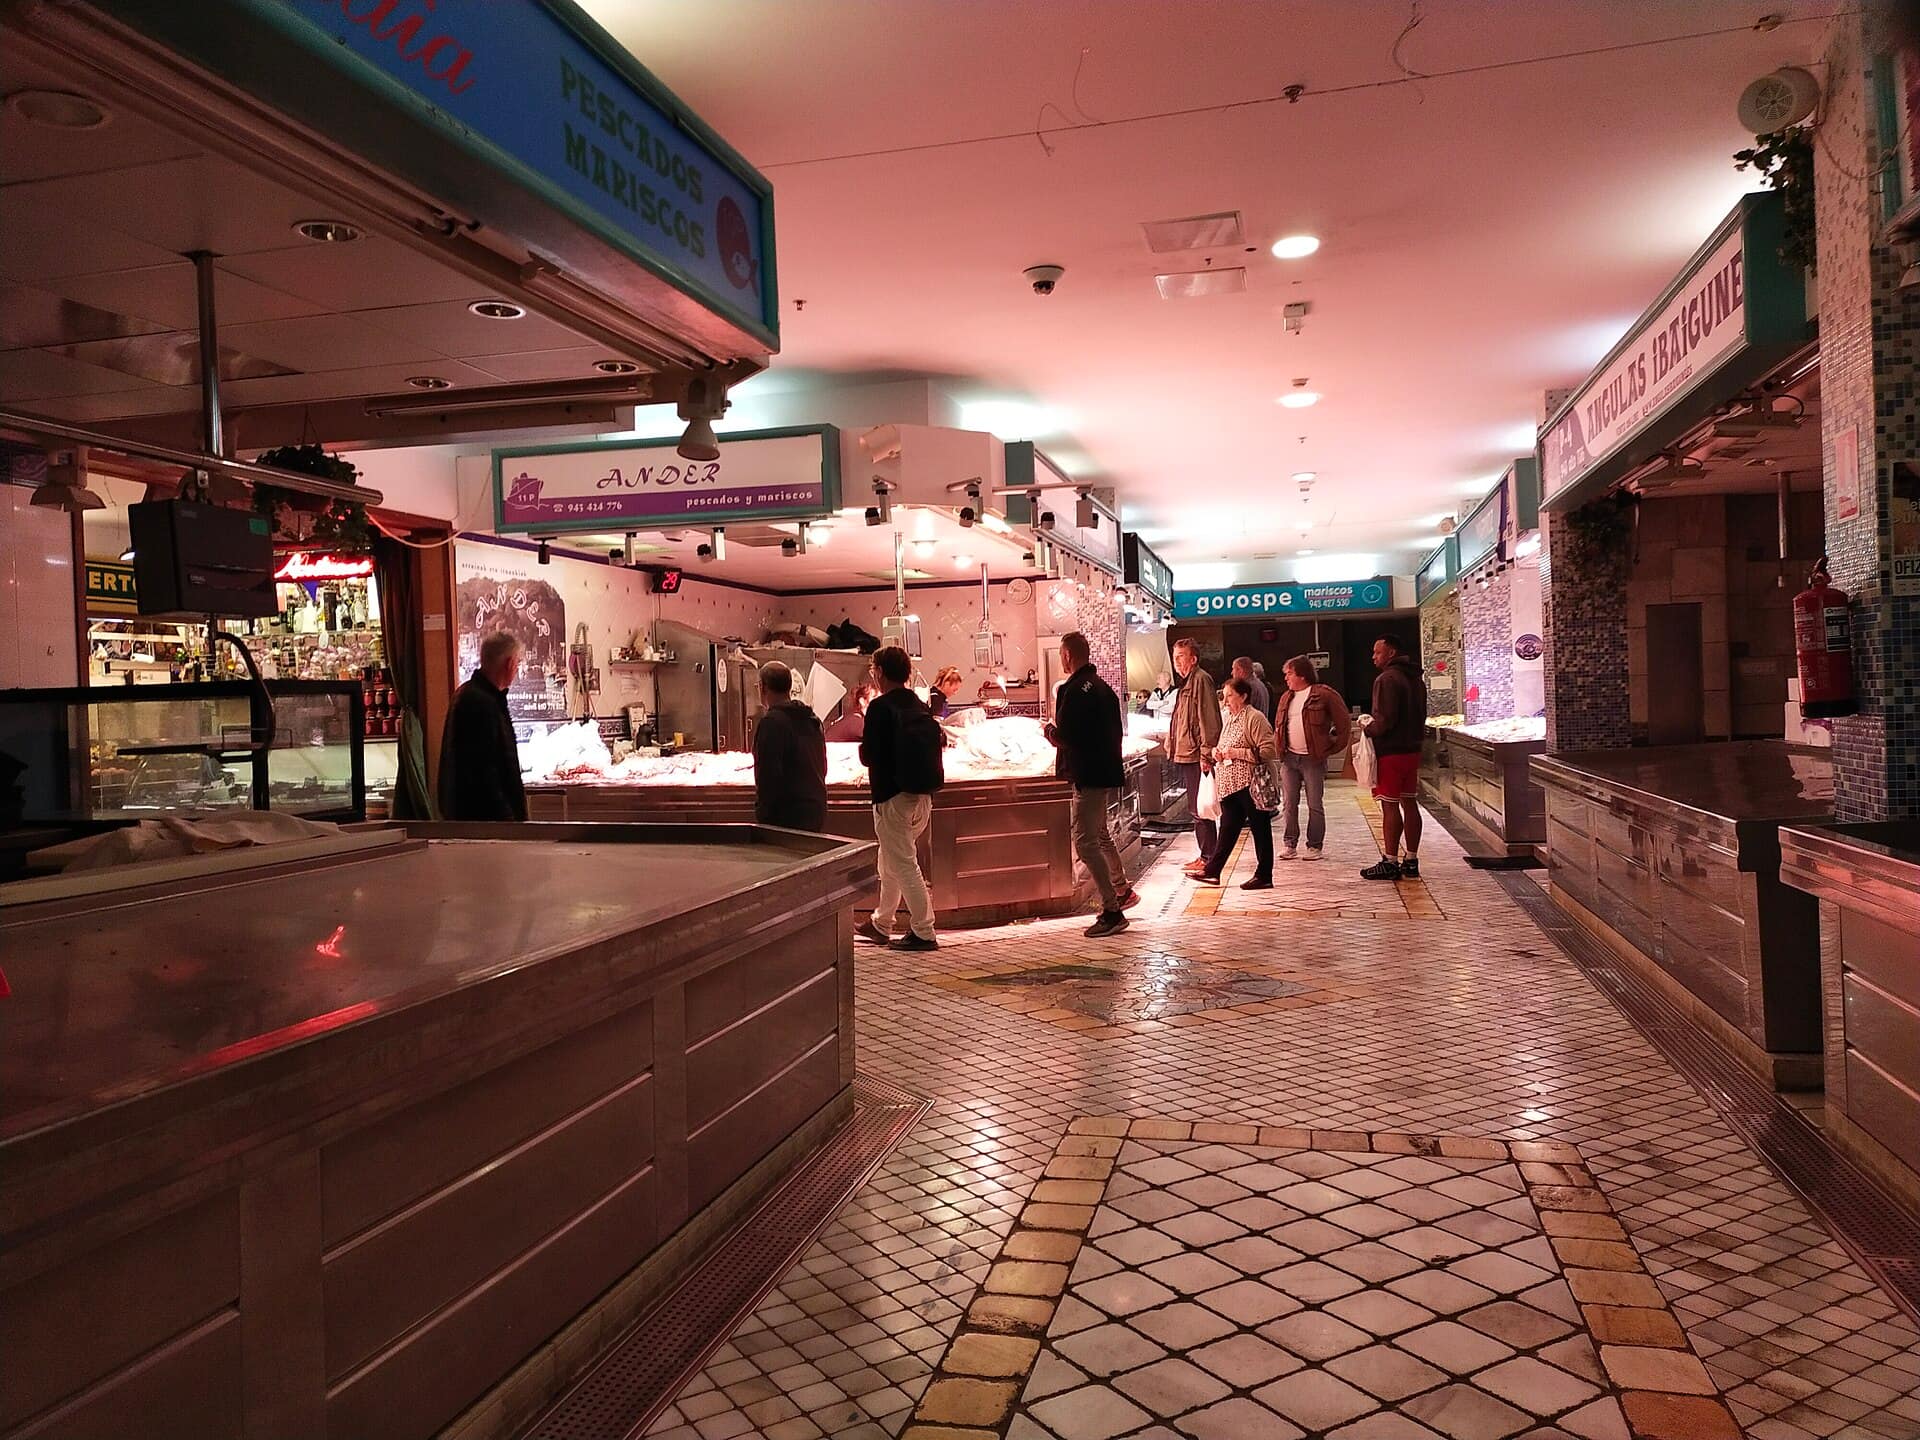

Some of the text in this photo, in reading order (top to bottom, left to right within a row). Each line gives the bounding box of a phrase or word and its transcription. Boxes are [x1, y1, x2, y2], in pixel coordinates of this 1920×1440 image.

[560, 56, 703, 205] PESCADOS
[564, 121, 704, 259] MARISCOS
[1587, 352, 1646, 444] ANGULAS
[596, 462, 721, 489] ANDER
[529, 493, 535, 502] P
[567, 503, 585, 513] 943
[607, 501, 623, 511] 776
[686, 490, 813, 509] pescados y mariscos
[89, 571, 137, 593] ERT
[662, 573, 678, 590] 29
[1304, 585, 1353, 598] mariscos
[1196, 592, 1292, 614] gorospe
